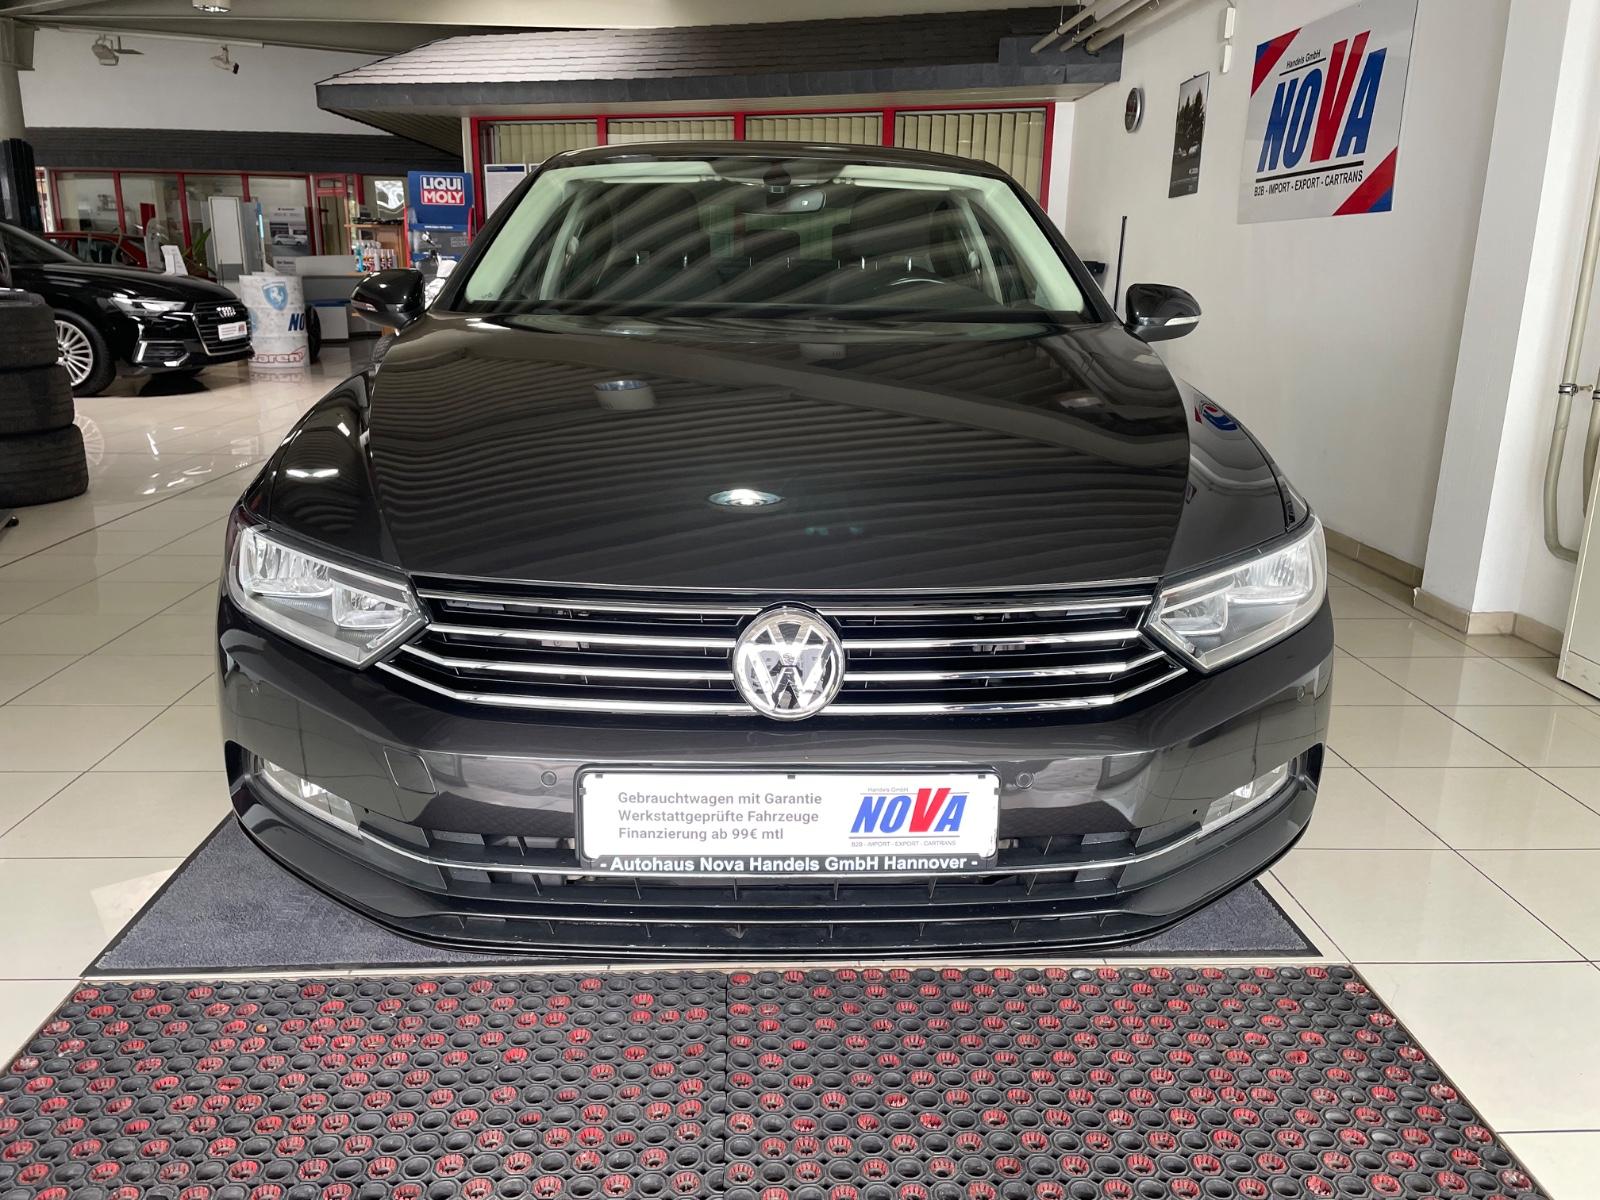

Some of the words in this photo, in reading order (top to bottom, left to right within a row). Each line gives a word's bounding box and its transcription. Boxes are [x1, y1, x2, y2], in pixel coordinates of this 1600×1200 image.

[1256, 30, 1388, 173] NOVA
[422, 177, 461, 190] LIQUI
[1268, 182, 1290, 194] IMPORT
[1294, 177, 1320, 191] EXPORT
[1324, 169, 1363, 187] CARTRANS
[423, 190, 463, 204] MOLY
[618, 792, 734, 807] Gebrauchtwagen
[738, 793, 760, 804] mit
[764, 793, 822, 805] Garantie
[618, 809, 744, 825] Werkstattgeprüfte
[747, 811, 819, 825] Fahrzeuge
[850, 788, 968, 833] NOVA
[618, 828, 707, 842] Finanzierung
[711, 828, 728, 840] ab
[732, 828, 757, 840] 99€
[762, 828, 784, 840] mtl
[609, 857, 695, 872] Autohaus
[699, 857, 744, 872] Nova
[750, 857, 820, 872] Handels
[824, 856, 879, 872] GmbH
[884, 856, 967, 871] Hannover
